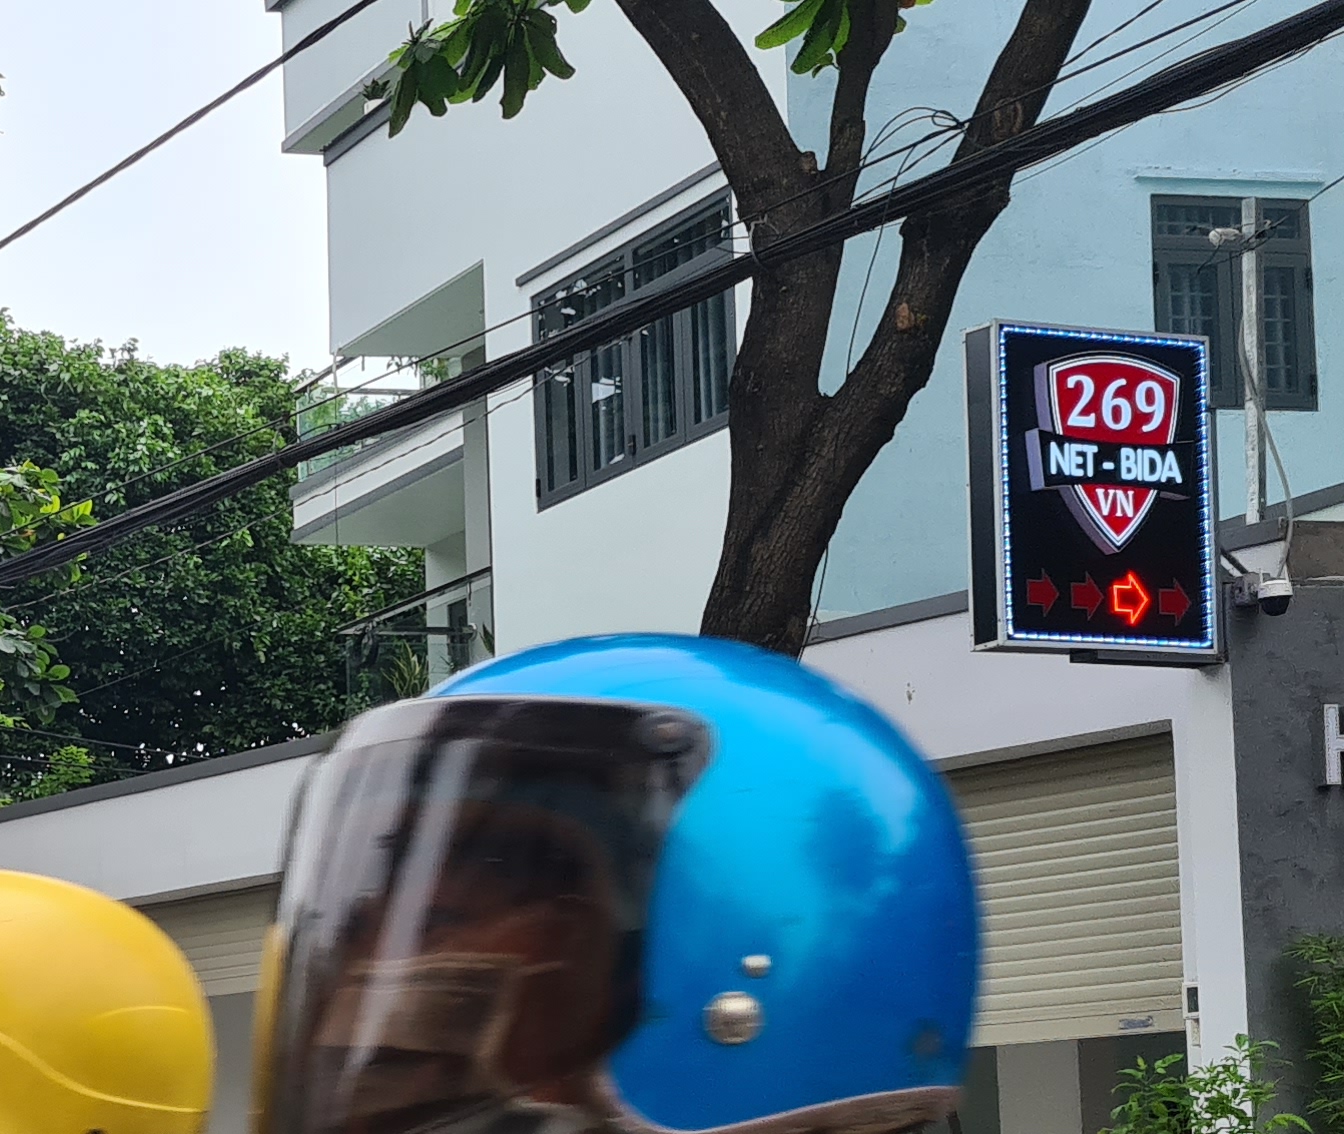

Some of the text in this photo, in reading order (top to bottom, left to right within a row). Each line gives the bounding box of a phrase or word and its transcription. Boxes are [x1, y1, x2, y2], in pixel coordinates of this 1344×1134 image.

[1067, 375, 1165, 432] 269
[1050, 442, 1098, 477] NET
[1120, 447, 1182, 484] BIDA
[1096, 488, 1134, 517] VN
